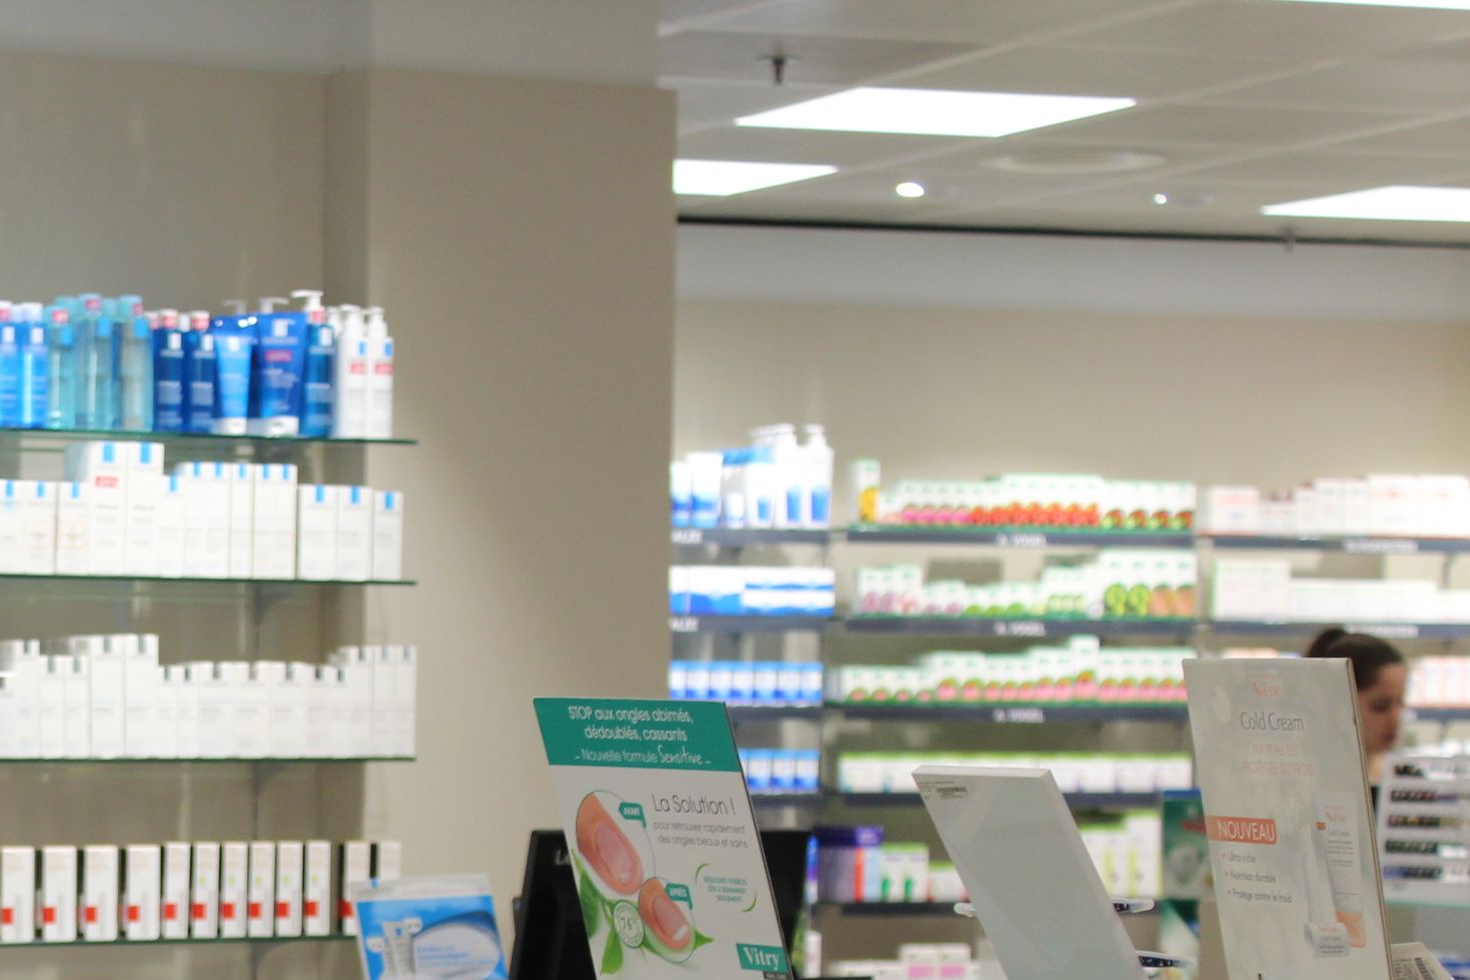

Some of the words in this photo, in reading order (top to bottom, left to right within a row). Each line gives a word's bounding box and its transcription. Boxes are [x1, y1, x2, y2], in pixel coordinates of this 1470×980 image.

[568, 706, 592, 720] STOP
[595, 709, 614, 720] aux
[616, 708, 651, 724] ongles
[1240, 712, 1266, 731] Cold
[1268, 712, 1305, 732] Cream
[584, 726, 642, 742] dédoublés,
[643, 728, 688, 741] cassants
[581, 749, 621, 762] Nouvelle
[623, 750, 658, 764] formule
[658, 744, 703, 765] Sensitive
[651, 793, 671, 813] La
[673, 794, 727, 815] Solution
[730, 798, 736, 815] !
[653, 822, 670, 832] pour
[703, 823, 745, 834] rapidement
[1218, 821, 1275, 841] NOUVEAU
[658, 835, 671, 844] des
[673, 837, 695, 847] ongles
[729, 839, 748, 849] sains
[743, 947, 780, 970] Vitry
